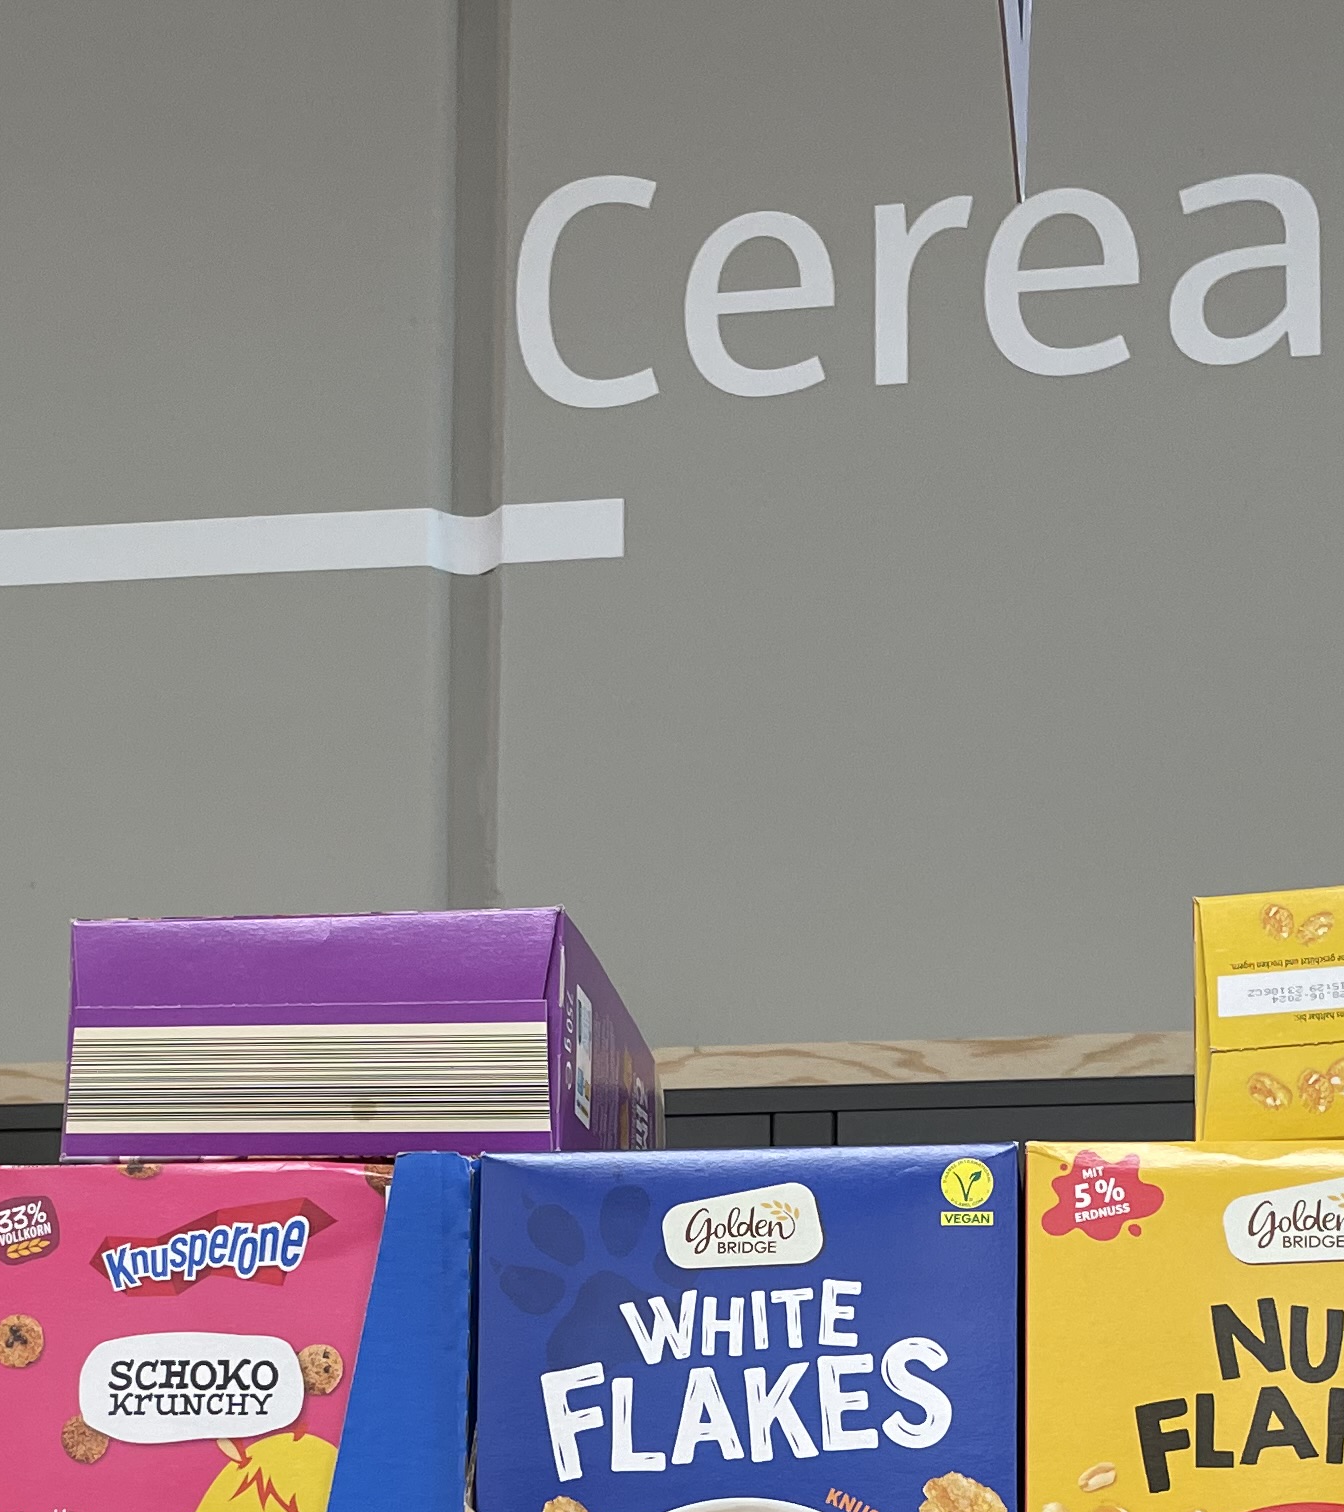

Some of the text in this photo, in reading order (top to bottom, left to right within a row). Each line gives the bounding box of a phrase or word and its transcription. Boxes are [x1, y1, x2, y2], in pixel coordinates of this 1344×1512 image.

[1081, 1165, 1105, 1181] MIT
[944, 1213, 990, 1224] VEGAN
[1074, 1202, 1132, 1223] ERDNUSS
[685, 1206, 796, 1257] Golden
[717, 1239, 777, 1255] BRIDGE
[103, 1215, 308, 1292] Knusperone
[619, 1279, 863, 1365] WHITE
[108, 1358, 279, 1391] SCHOKO
[540, 1336, 953, 1481] FLAKES
